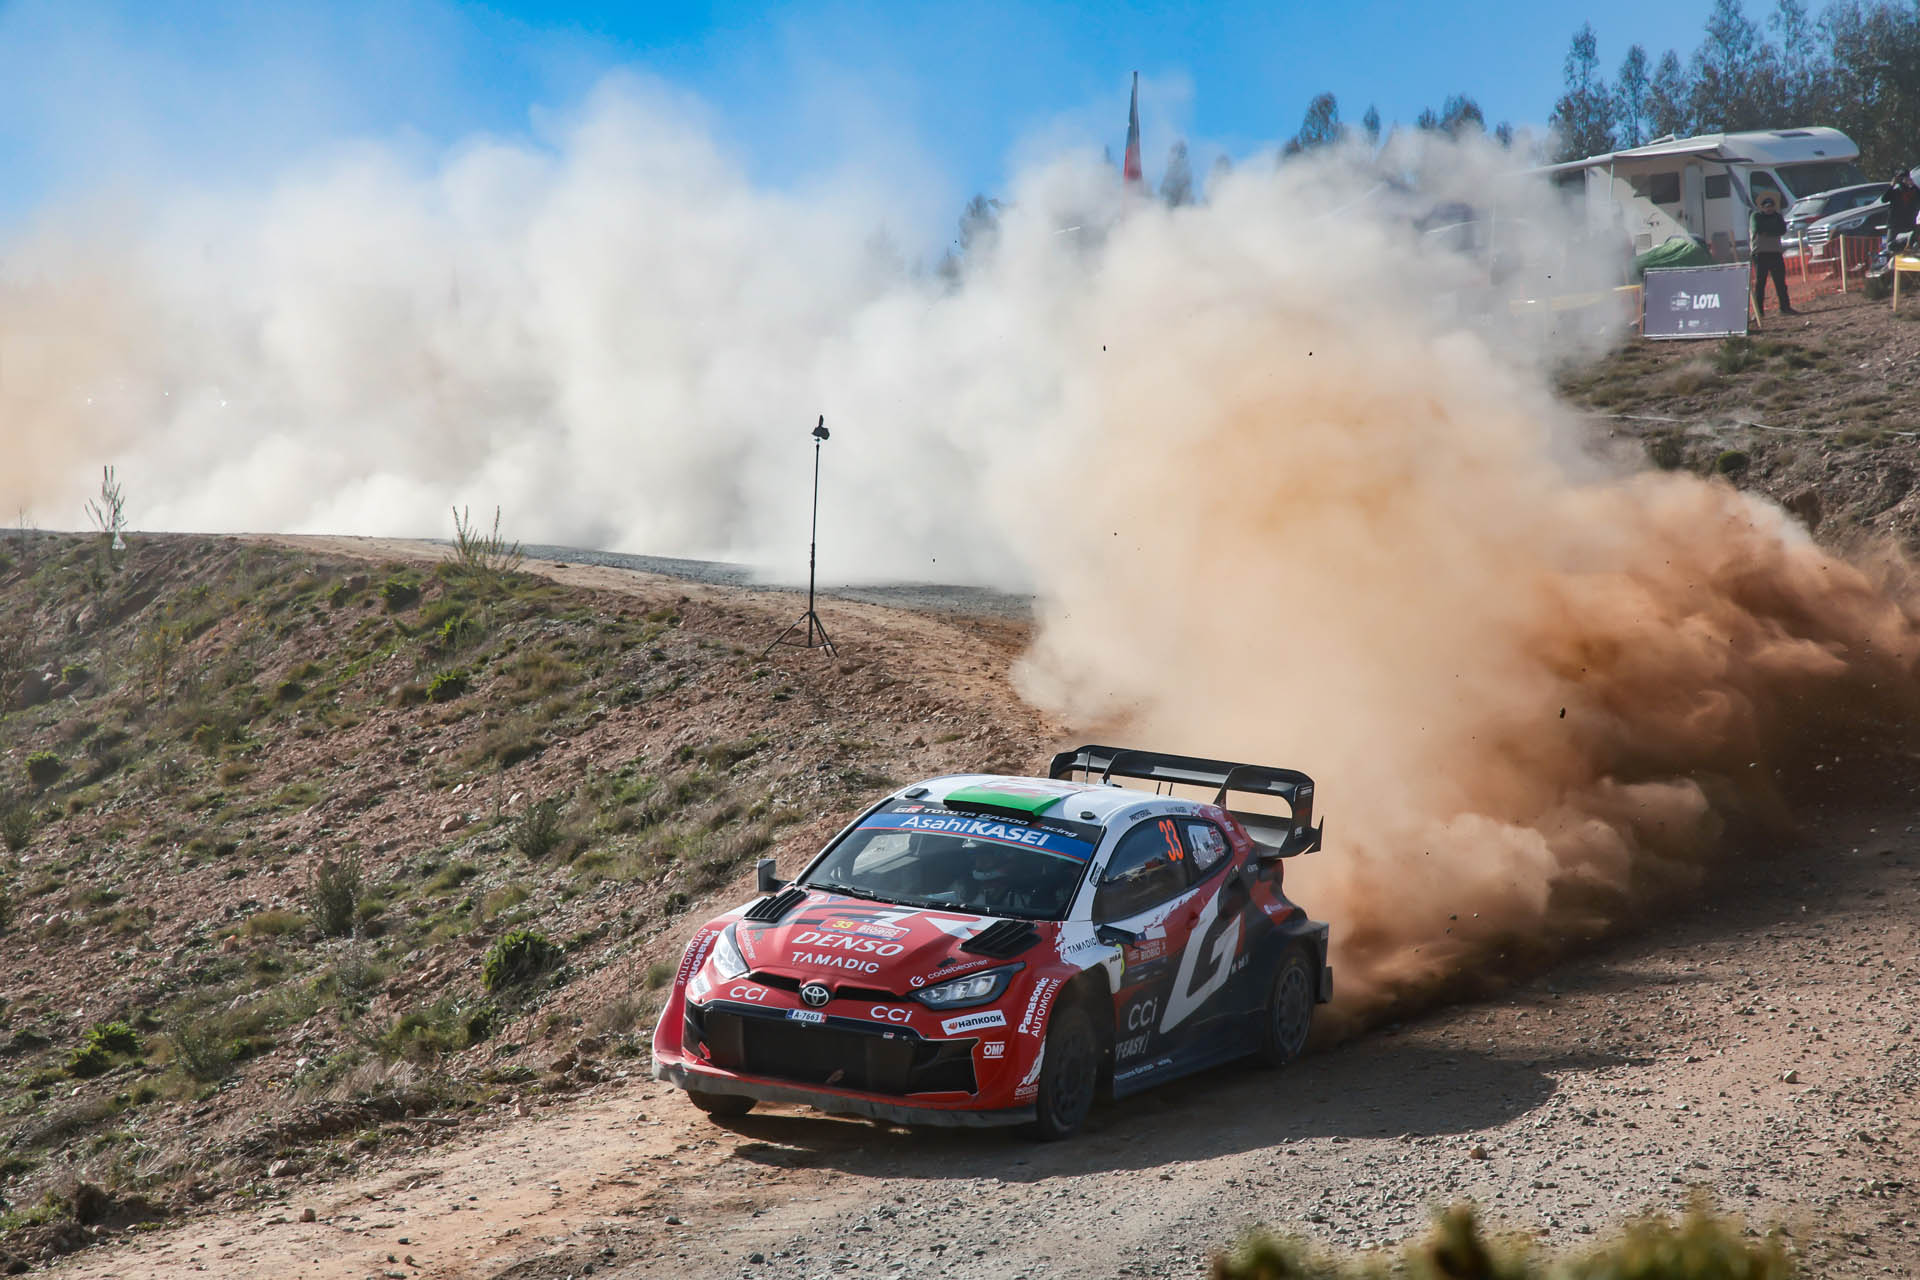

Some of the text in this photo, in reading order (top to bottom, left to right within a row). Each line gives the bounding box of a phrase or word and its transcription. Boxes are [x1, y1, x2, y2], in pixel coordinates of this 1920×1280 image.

[1693, 293, 1720, 309] LOTA
[924, 808, 977, 818] TOYOTA
[1032, 821, 1079, 838] Racing
[1158, 819, 1184, 861] 33
[832, 920, 855, 929] 33
[792, 931, 905, 957] DENSO
[1067, 936, 1099, 954] TAMADIC
[676, 927, 709, 987] AUTOMOTIVE
[792, 951, 880, 974] TAMADIC
[927, 959, 989, 980] codebeamer
[794, 1009, 820, 1022] A-7663
[1018, 976, 1050, 1034] Panasonic
[1031, 978, 1062, 1038] AUTOMOTIVE
[983, 1043, 1006, 1056] OMP
